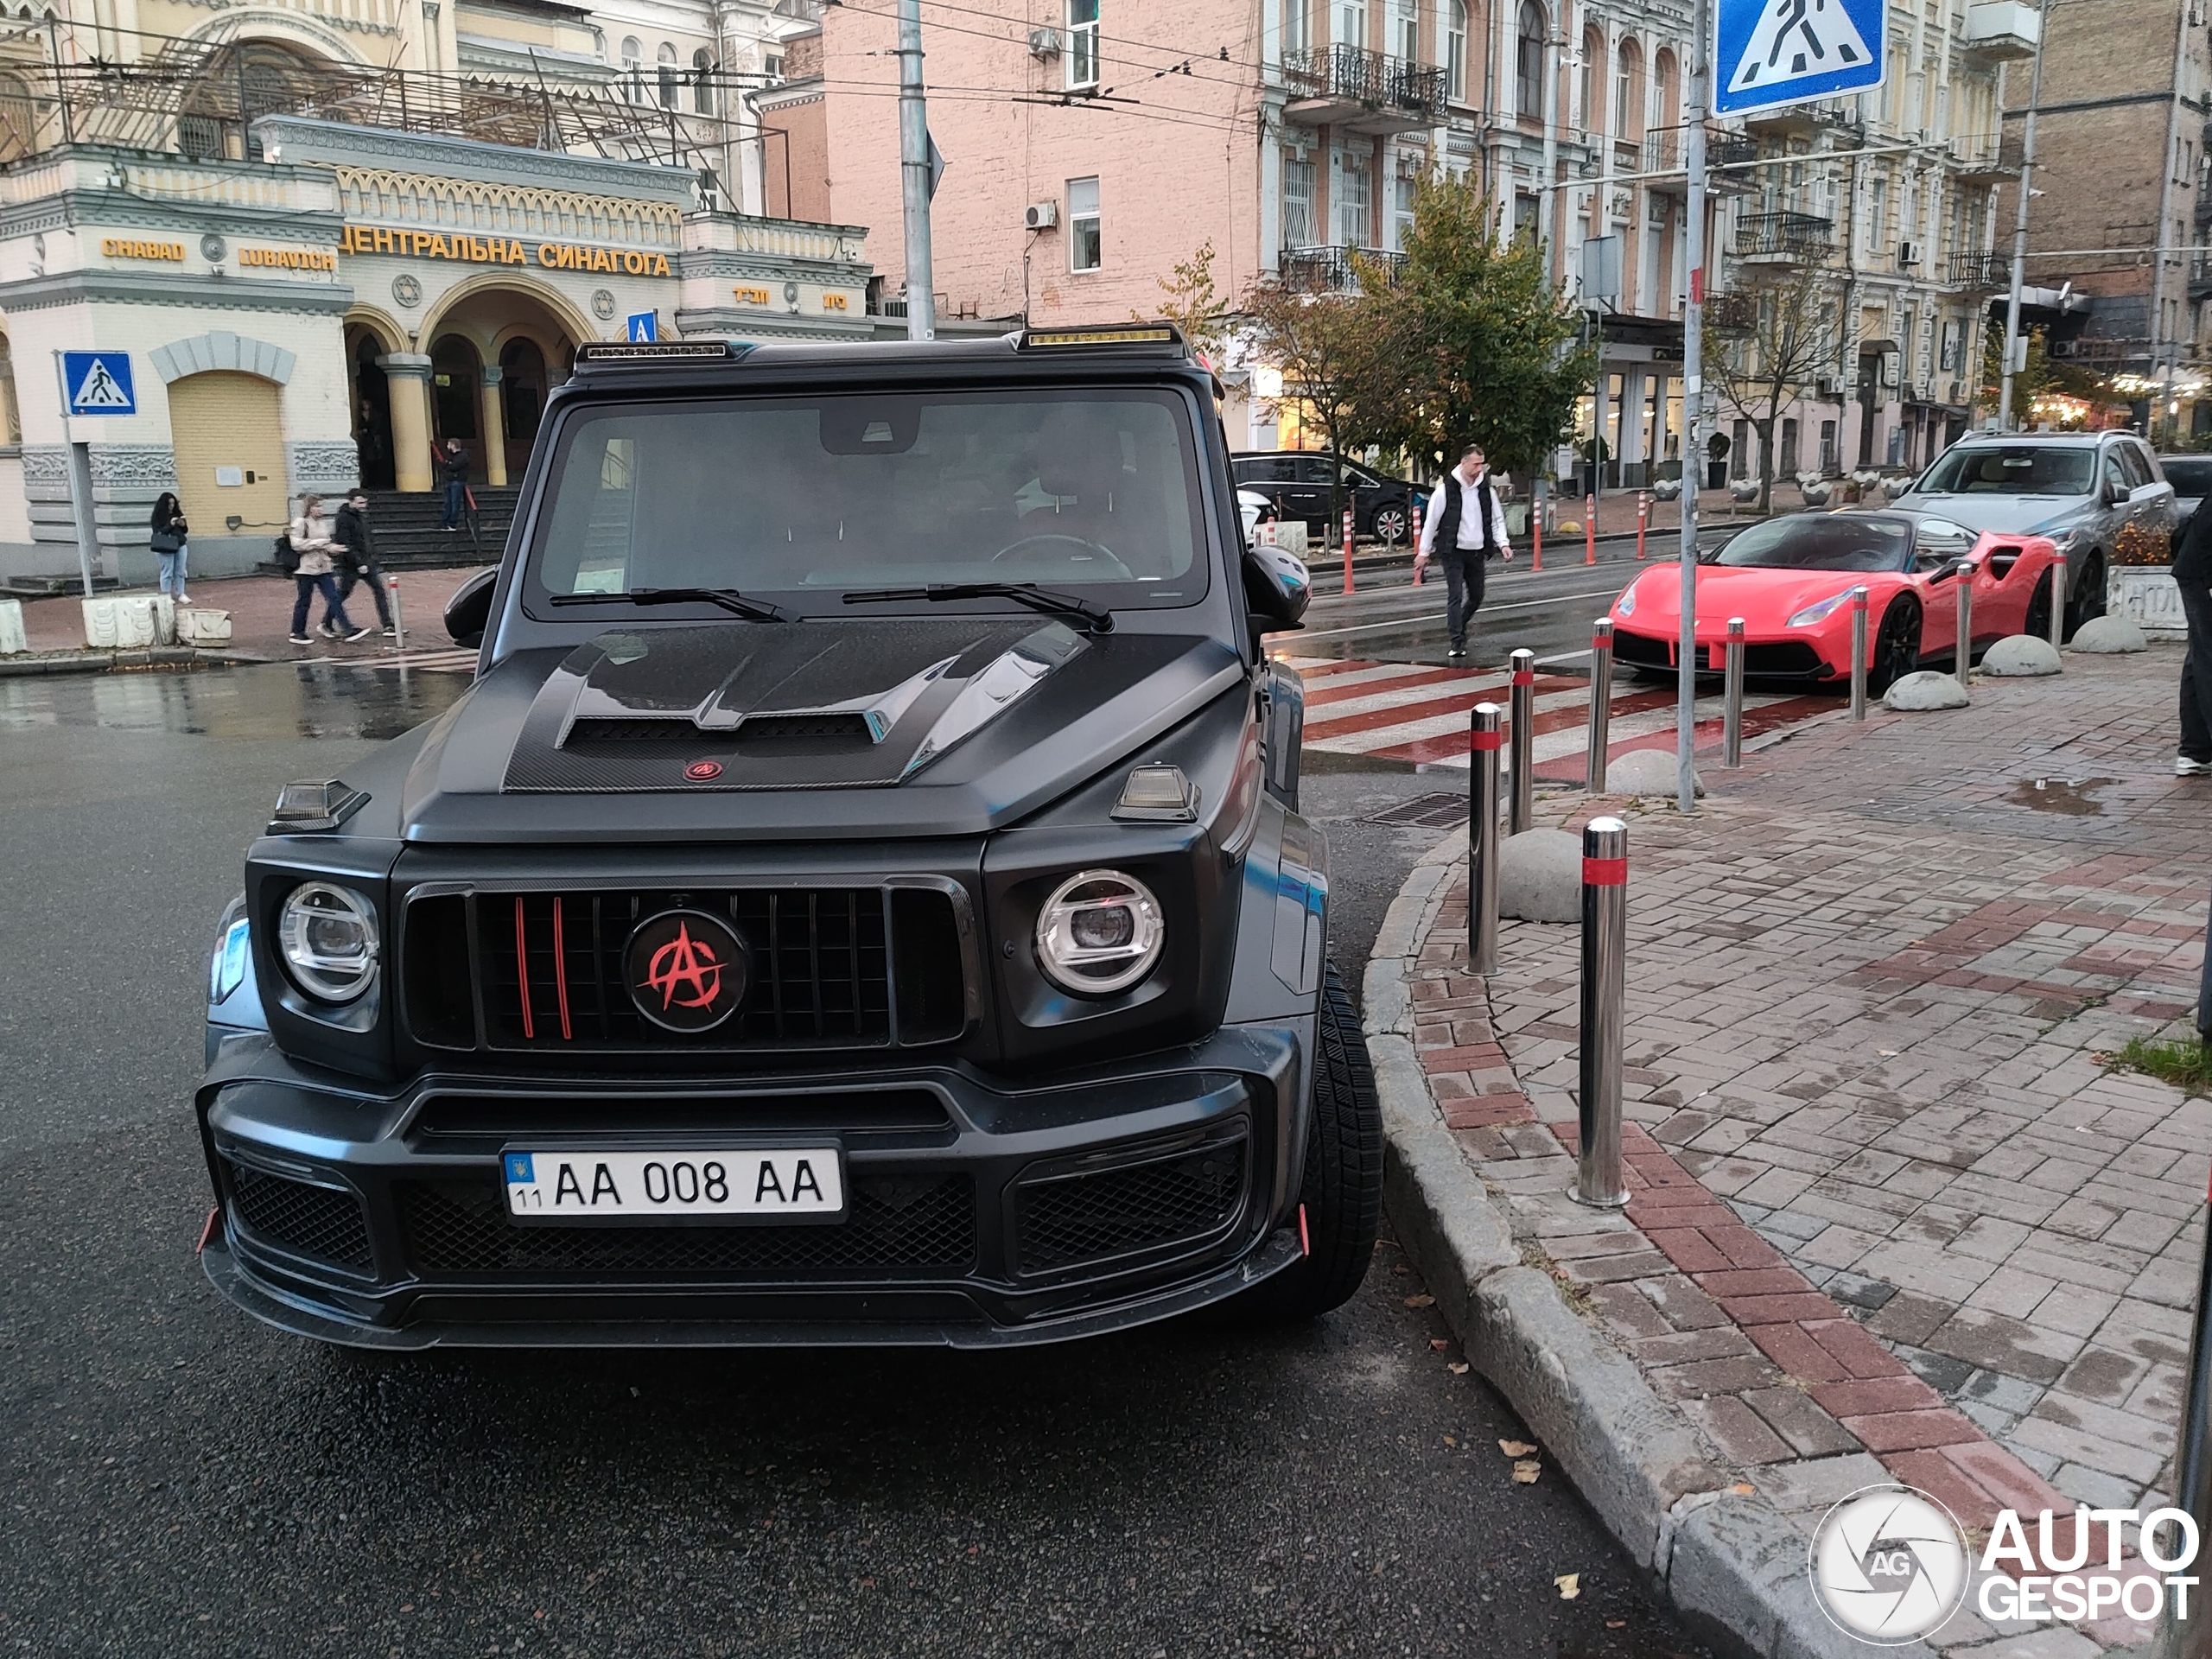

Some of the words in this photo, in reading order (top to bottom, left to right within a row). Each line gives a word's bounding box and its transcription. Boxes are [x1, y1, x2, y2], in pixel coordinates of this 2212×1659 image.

[101, 238, 186, 261] CHABAD
[238, 247, 336, 271] LUBAVICH
[337, 225, 526, 264] ЦЕНТРАЛЬНА
[538, 243, 671, 276] СИНАГОГА
[514, 1188, 543, 1209] 11
[555, 1162, 623, 1205] AA
[643, 1160, 729, 1204] 008
[754, 1160, 824, 1203] AA
